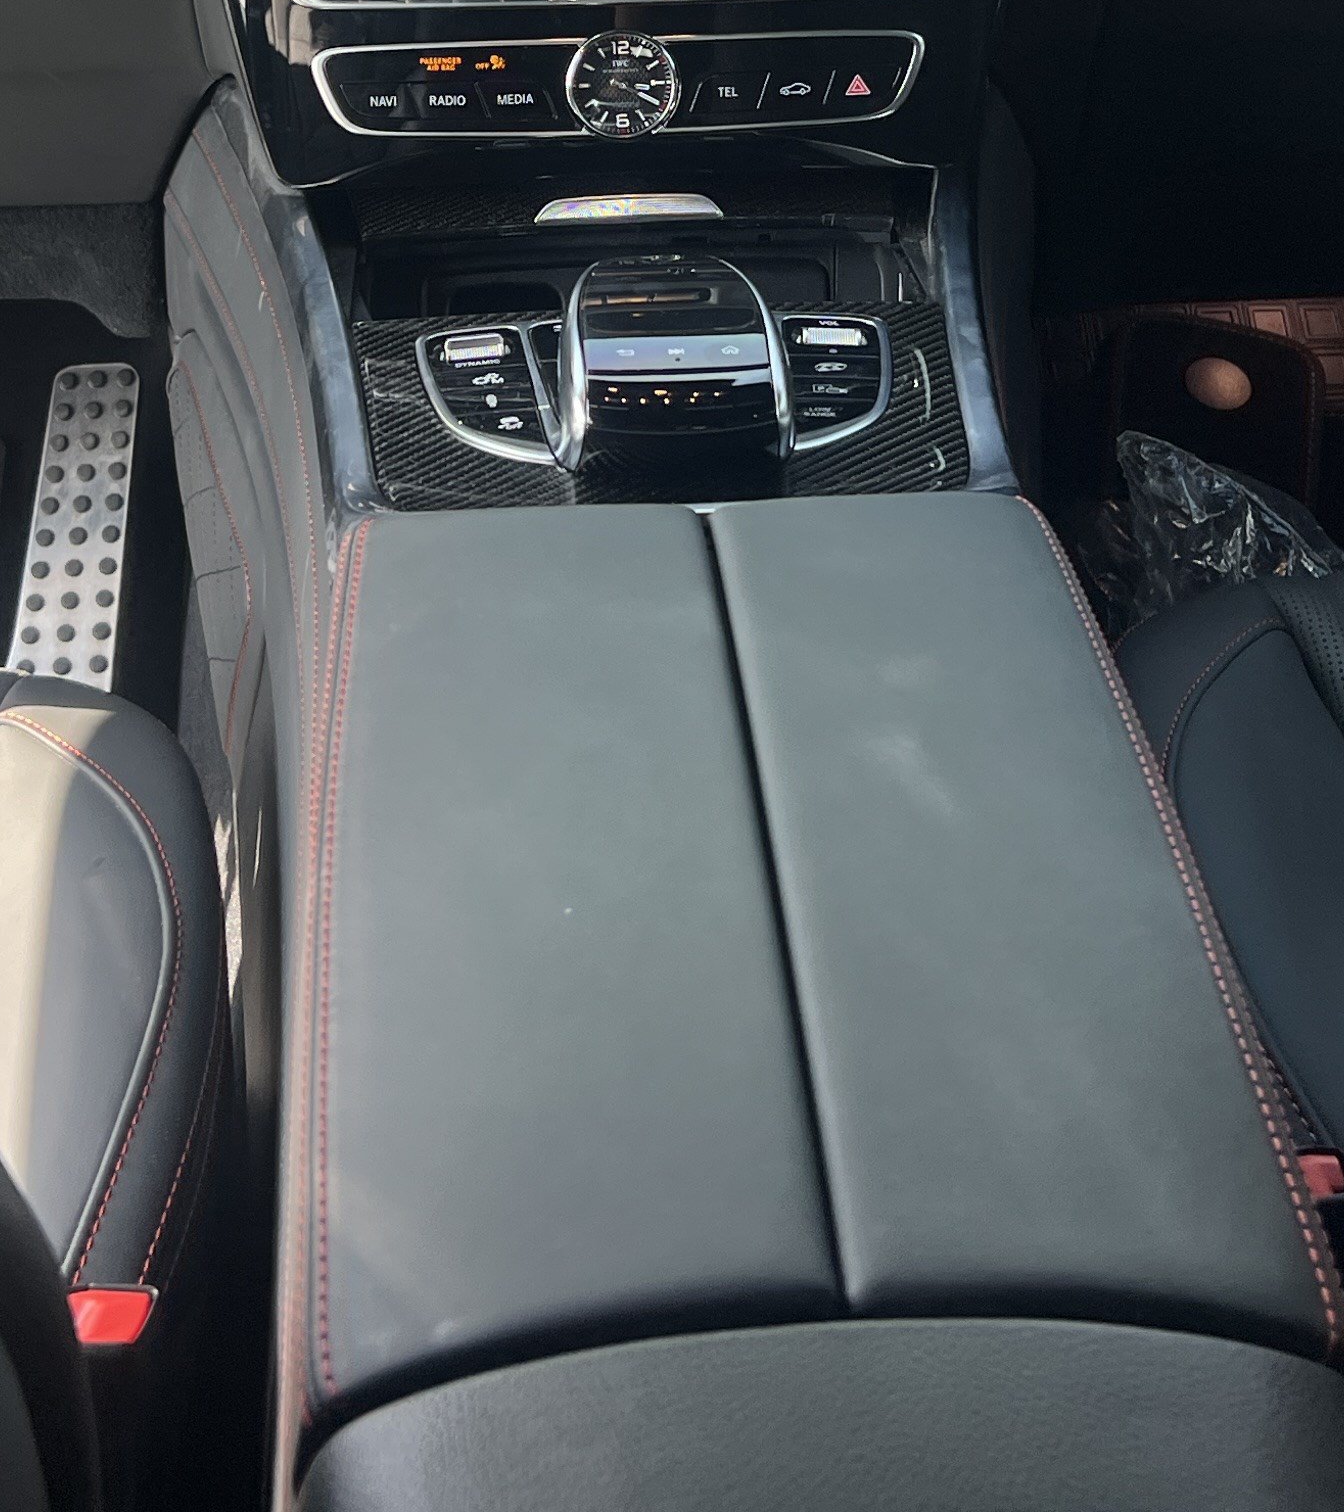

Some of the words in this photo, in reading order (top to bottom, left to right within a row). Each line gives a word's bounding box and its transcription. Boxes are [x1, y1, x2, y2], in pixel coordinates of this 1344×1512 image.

[611, 41, 630, 55] 12
[419, 57, 462, 65] PASSENGER
[475, 62, 489, 70] OFF
[718, 86, 738, 98] TEL
[369, 96, 397, 107] NAVI
[429, 95, 466, 106] RADIO
[497, 93, 534, 105] MEDIA
[615, 113, 630, 128] 6
[455, 359, 501, 368] DYNAMIC
